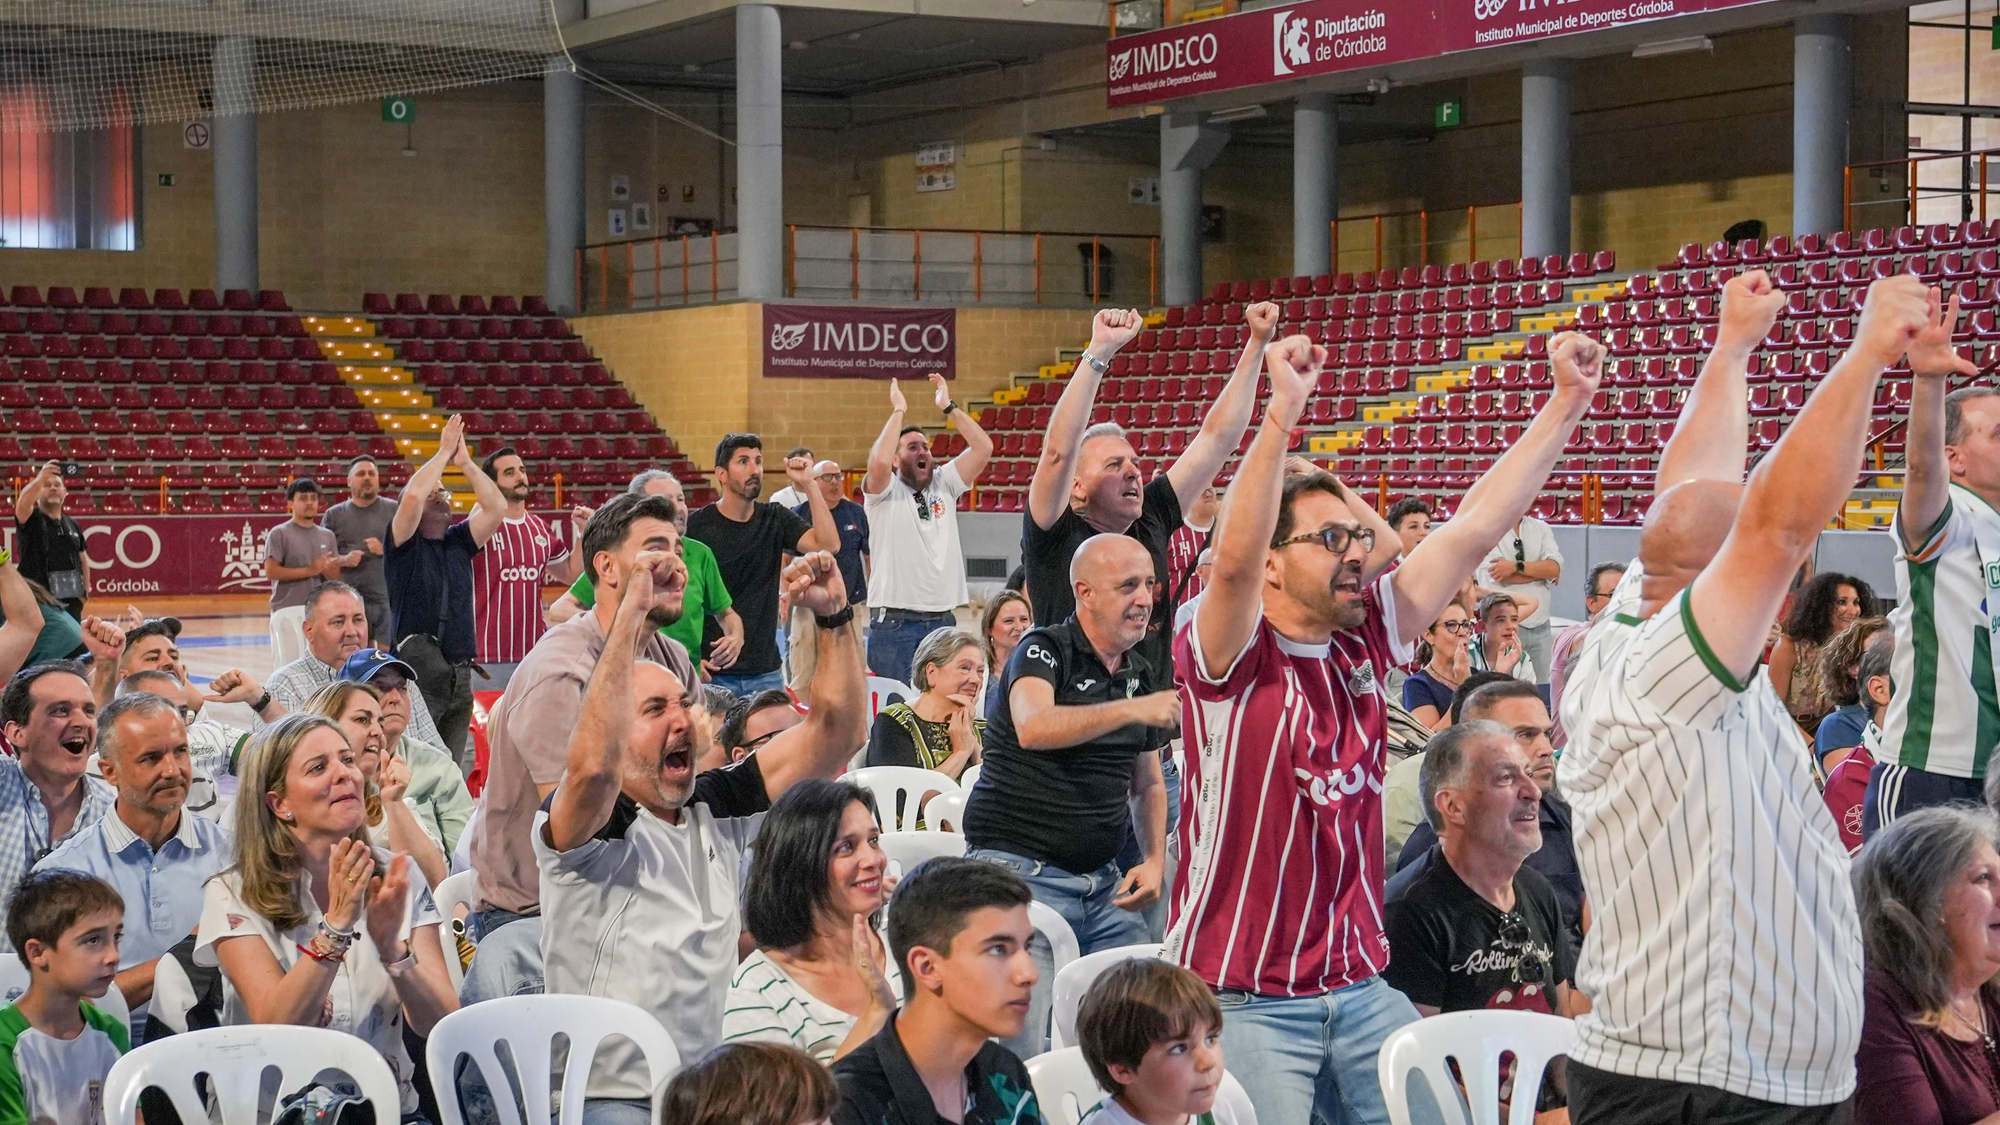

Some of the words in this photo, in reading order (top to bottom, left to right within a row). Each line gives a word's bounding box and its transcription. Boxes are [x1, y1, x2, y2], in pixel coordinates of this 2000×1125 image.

[1315, 9, 1386, 40] Diputación
[1475, 26, 1514, 43] Instituto
[1515, 19, 1563, 37] Municipal
[1565, 16, 1578, 28] de
[1580, 9, 1628, 27] Deportes
[1629, 0, 1674, 17] Córdoba
[1133, 33, 1218, 76] IMDECO
[1315, 43, 1332, 61] de
[1334, 34, 1387, 58] Córdoba
[1132, 79, 1159, 93] Municipal
[1159, 78, 1166, 88] de
[1166, 74, 1192, 88] Deportes
[1192, 69, 1217, 82] Córdoba
[1443, 102, 1453, 122] F
[813, 322, 949, 353] IMDECO
[771, 356, 808, 367] Instituto
[811, 357, 854, 369] Municipal
[855, 357, 867, 368] de
[869, 358, 909, 370] Deportes
[910, 357, 947, 368] Córdoba
[96, 578, 160, 592] Córdoba
[1450, 948, 1519, 983] Rolling
